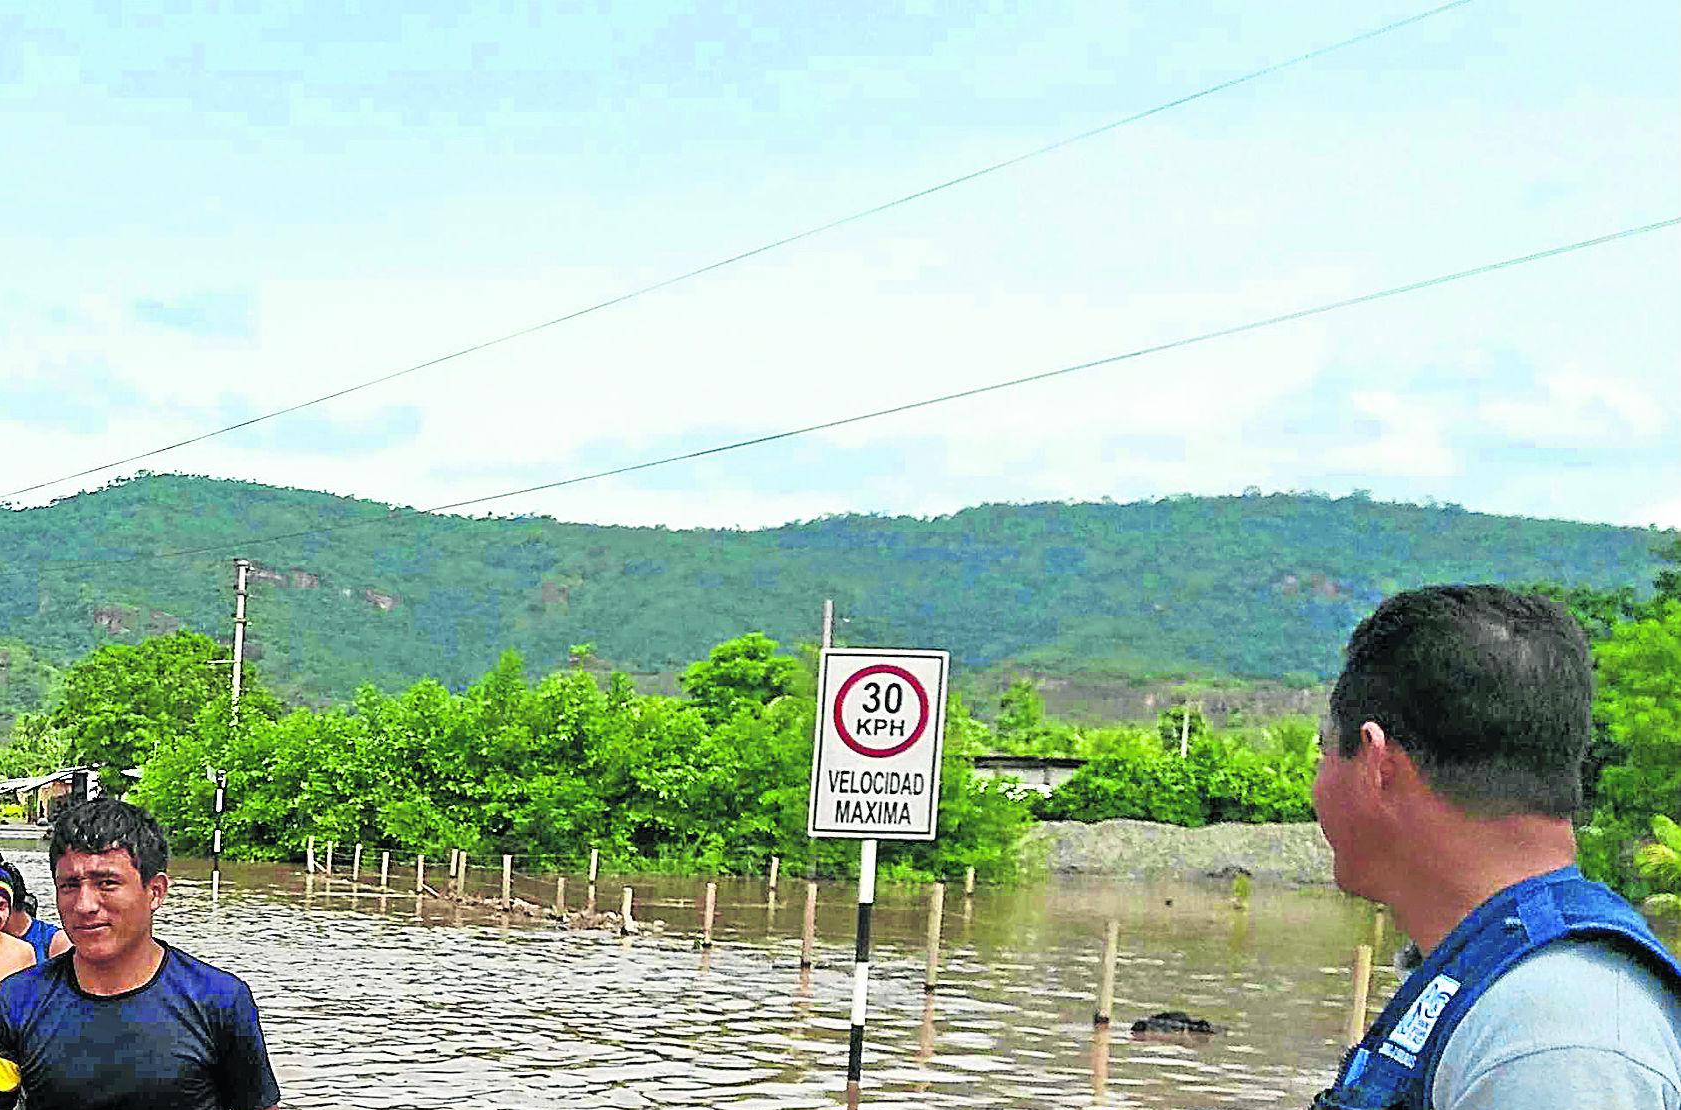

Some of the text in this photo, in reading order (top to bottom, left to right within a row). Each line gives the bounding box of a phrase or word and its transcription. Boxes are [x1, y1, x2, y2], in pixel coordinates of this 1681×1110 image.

[862, 682, 903, 714] 30
[856, 718, 905, 736] KPH
[829, 770, 925, 796] VELOCIDAD
[835, 800, 912, 825] MAXIMA
